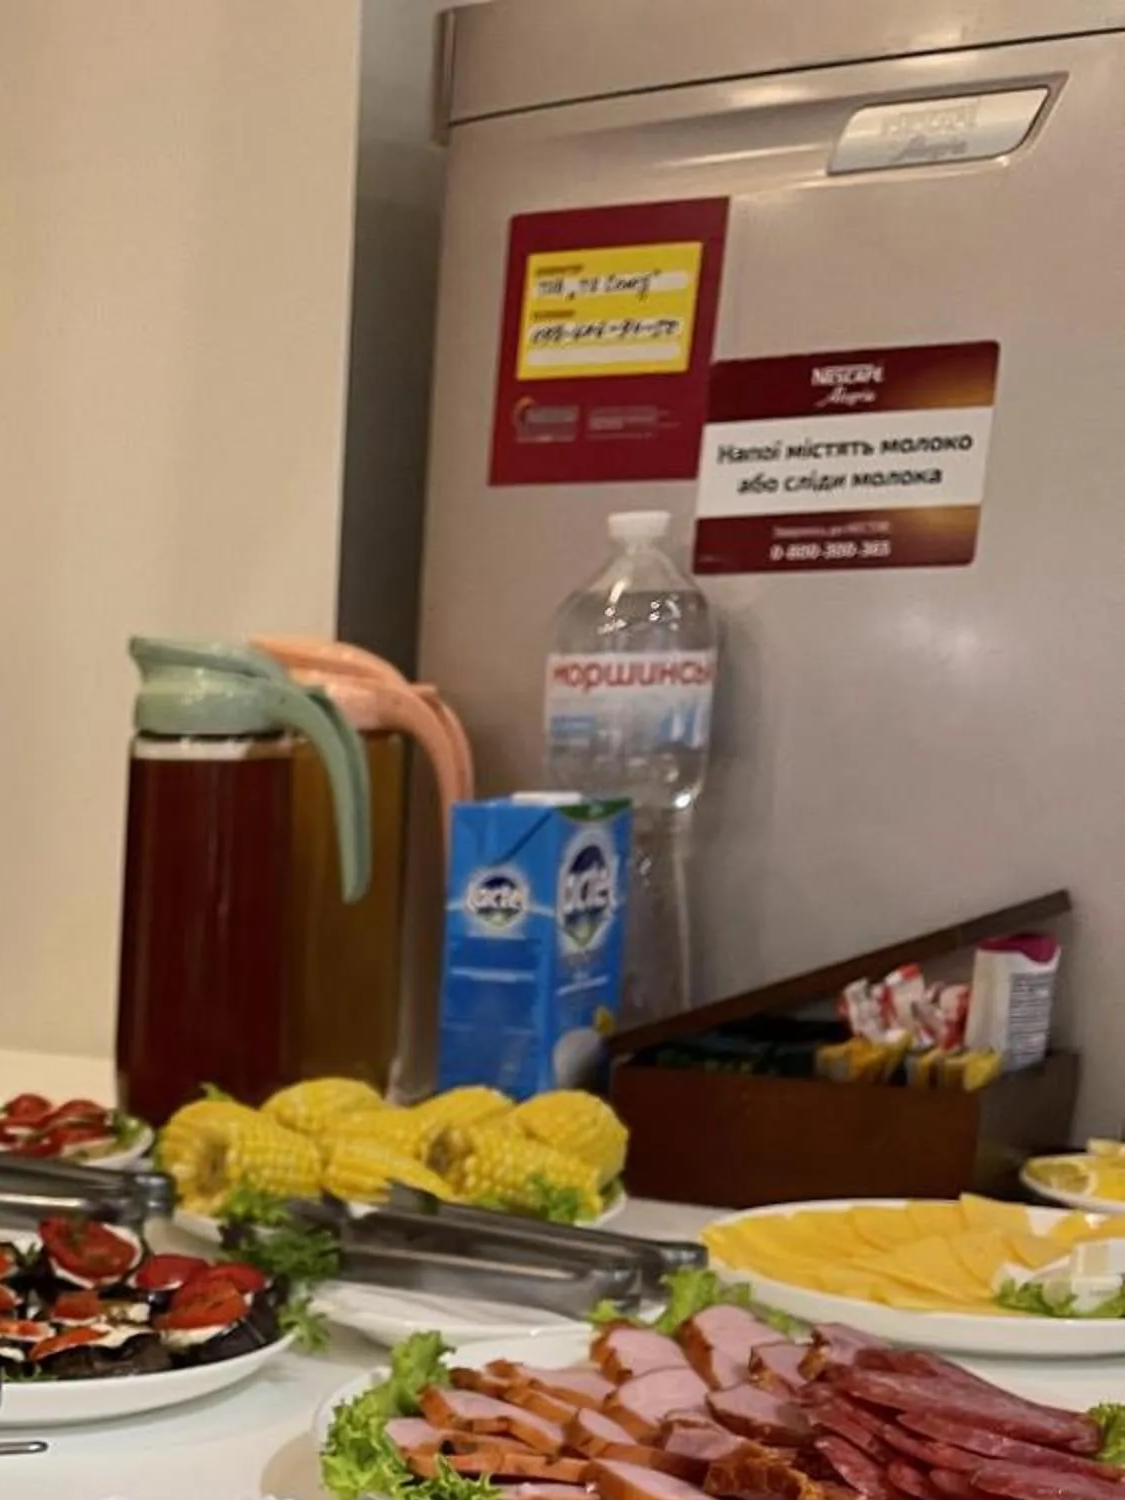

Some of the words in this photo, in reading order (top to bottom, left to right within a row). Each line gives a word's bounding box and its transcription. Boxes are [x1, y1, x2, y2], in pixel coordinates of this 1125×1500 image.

[717, 441, 782, 464] Напої
[786, 437, 873, 460] містять
[881, 434, 973, 454] молоко
[737, 473, 779, 495] або
[784, 469, 845, 492] сліди
[851, 468, 943, 488] молока
